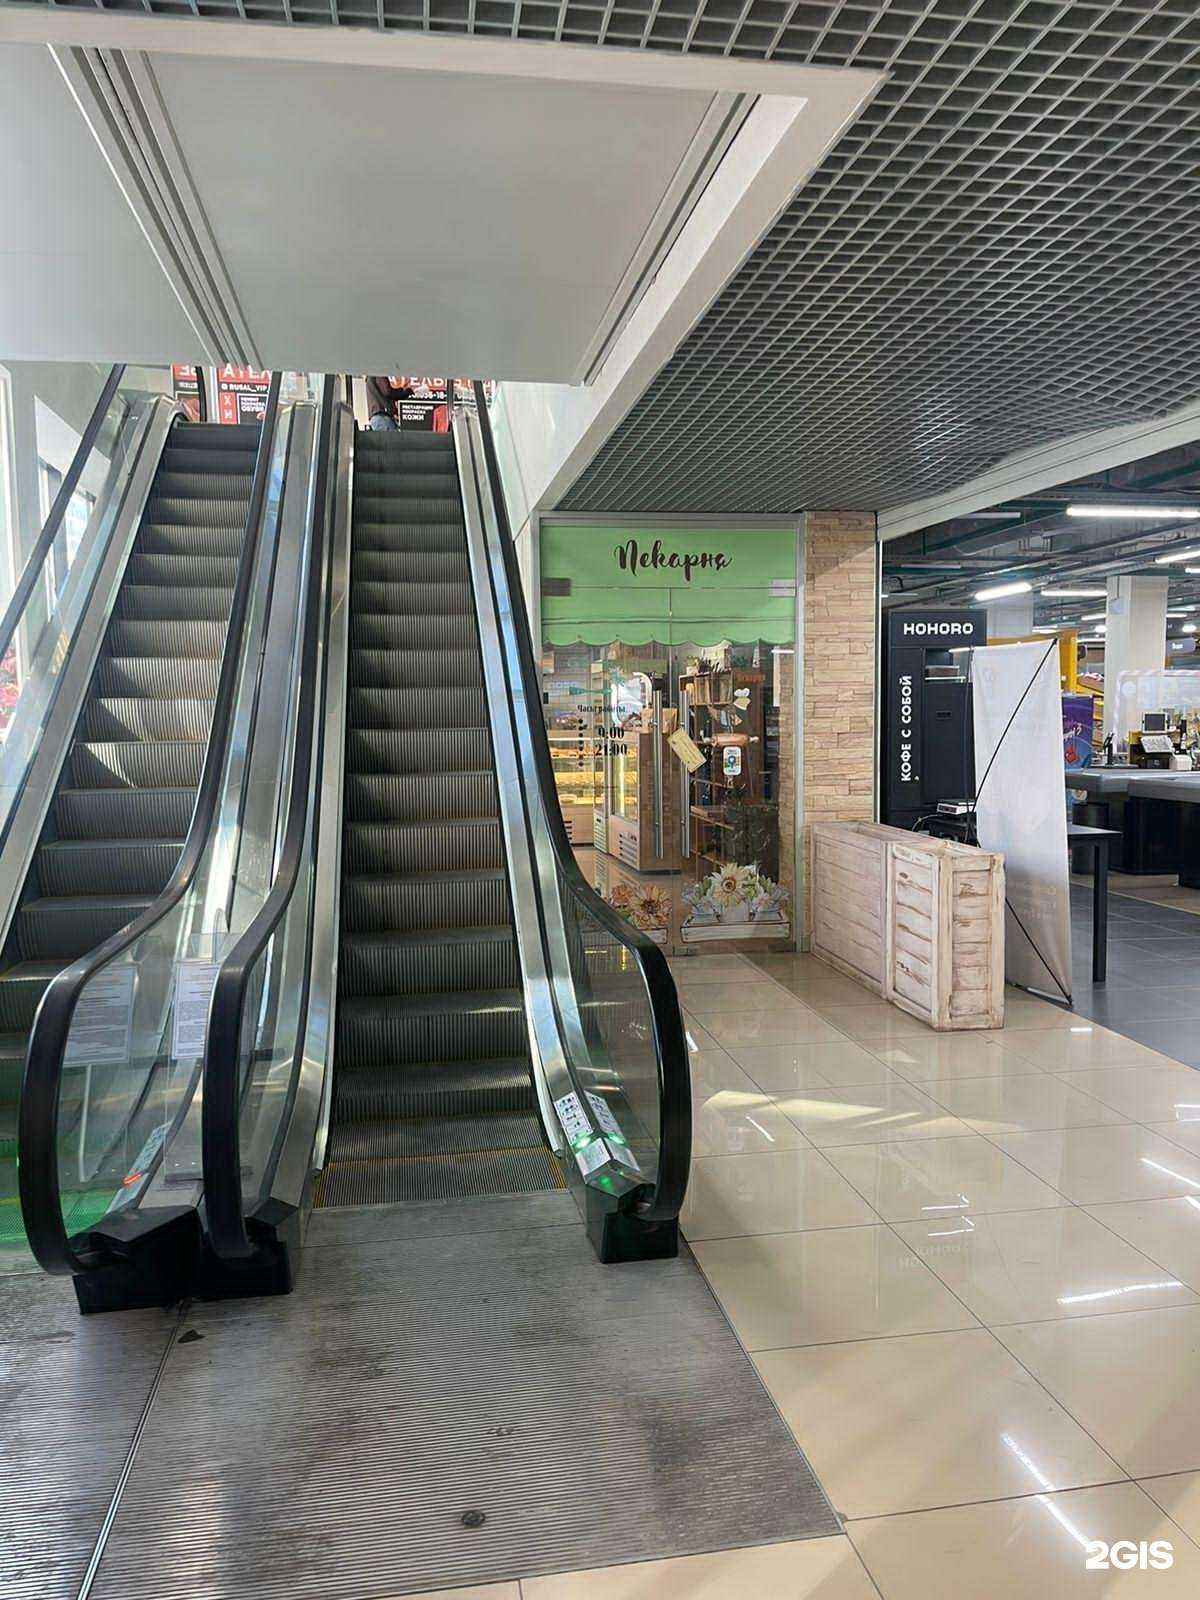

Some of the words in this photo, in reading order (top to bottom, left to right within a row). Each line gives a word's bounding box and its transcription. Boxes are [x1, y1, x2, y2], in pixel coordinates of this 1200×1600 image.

[613, 539, 733, 582] Пекарня
[903, 622, 974, 636] HOHORO
[899, 675, 912, 724] СОБОЙ
[577, 704, 596, 713] Часы
[901, 729, 912, 738] С
[594, 743, 628, 757] 21:00
[901, 743, 913, 782] КОФЕ
